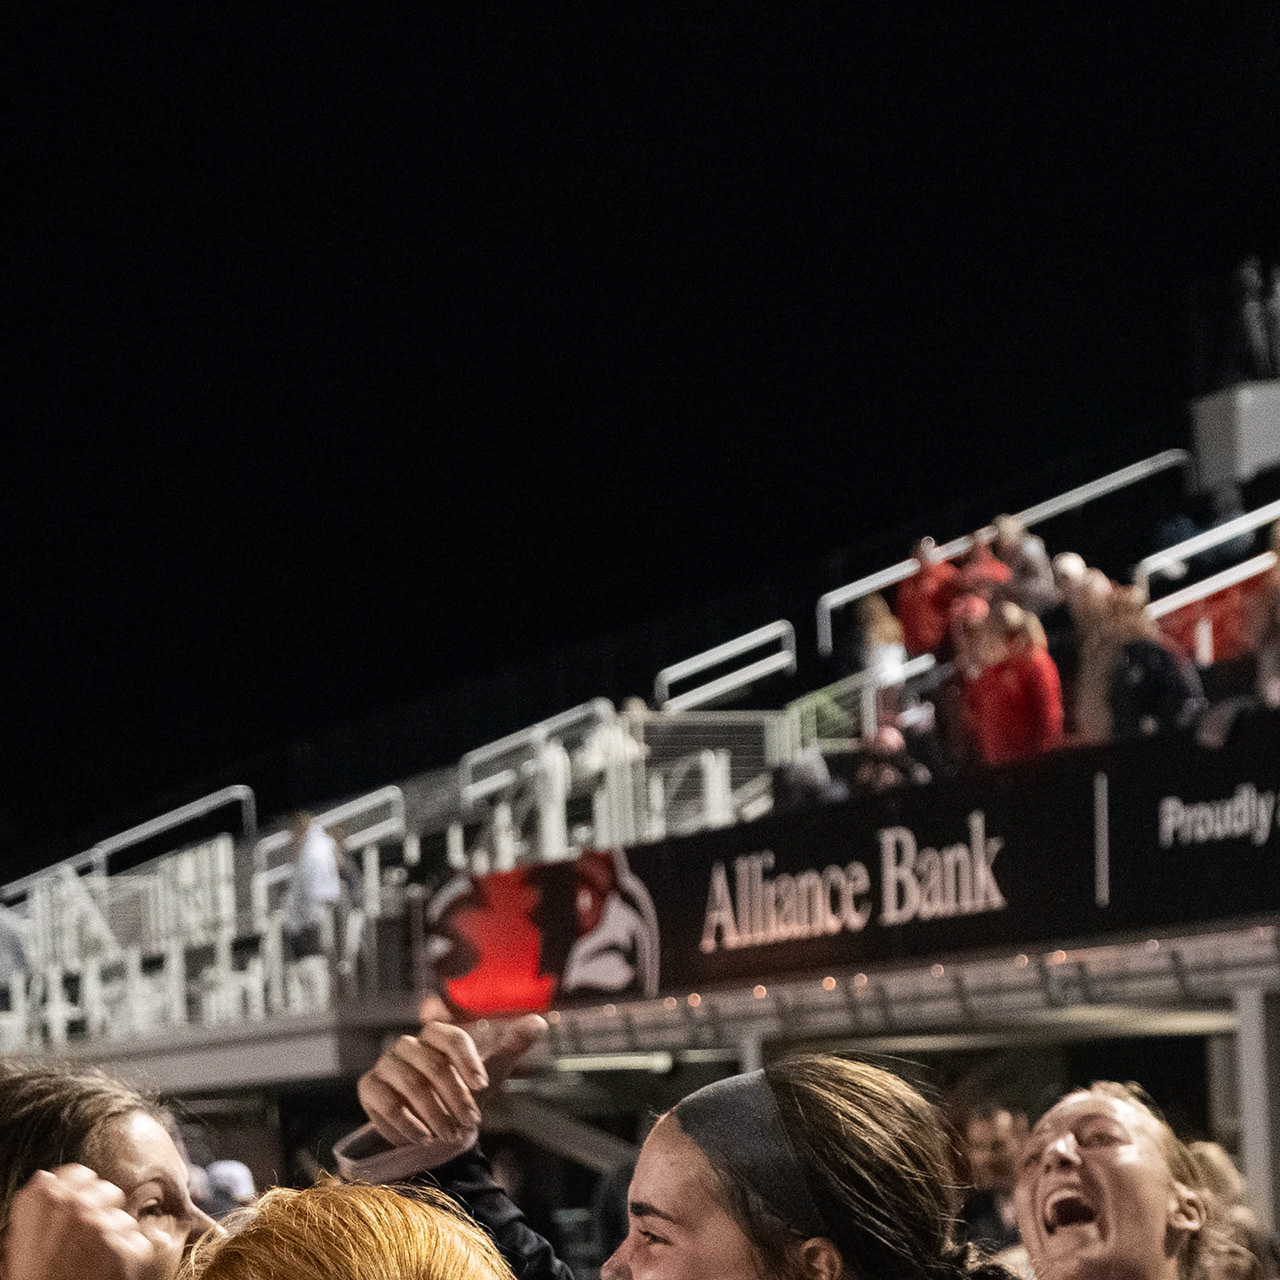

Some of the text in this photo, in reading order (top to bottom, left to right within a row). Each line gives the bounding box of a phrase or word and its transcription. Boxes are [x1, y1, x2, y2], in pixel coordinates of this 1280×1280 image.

[1158, 795, 1275, 848] Proudly
[699, 809, 1007, 953] Alliance Bank
